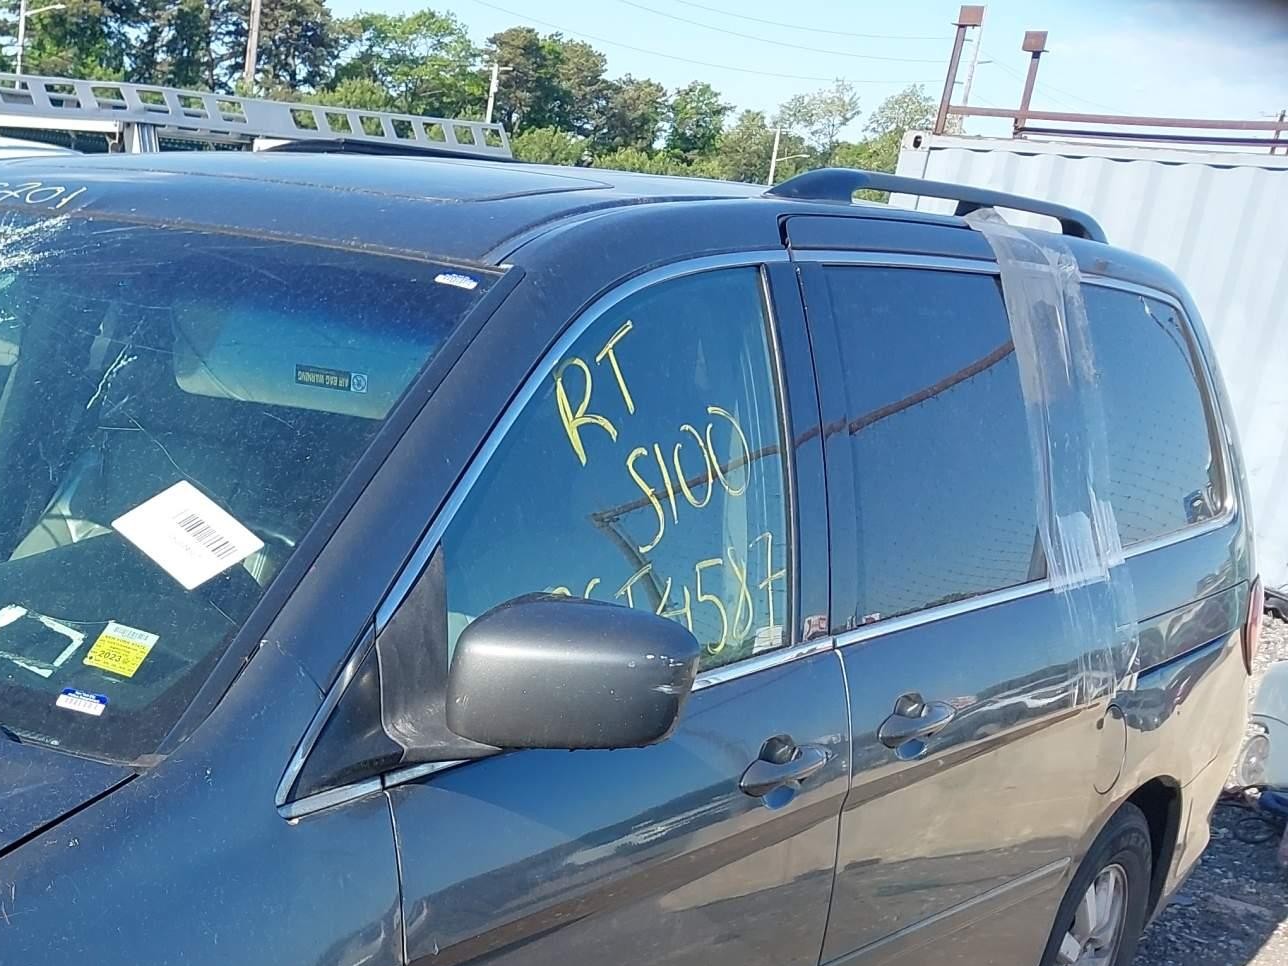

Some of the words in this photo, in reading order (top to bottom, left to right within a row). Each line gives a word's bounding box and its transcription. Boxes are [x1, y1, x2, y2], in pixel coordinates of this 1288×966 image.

[553, 319, 636, 467] RT
[626, 404, 752, 554] S100
[97, 650, 122, 662] 2023
